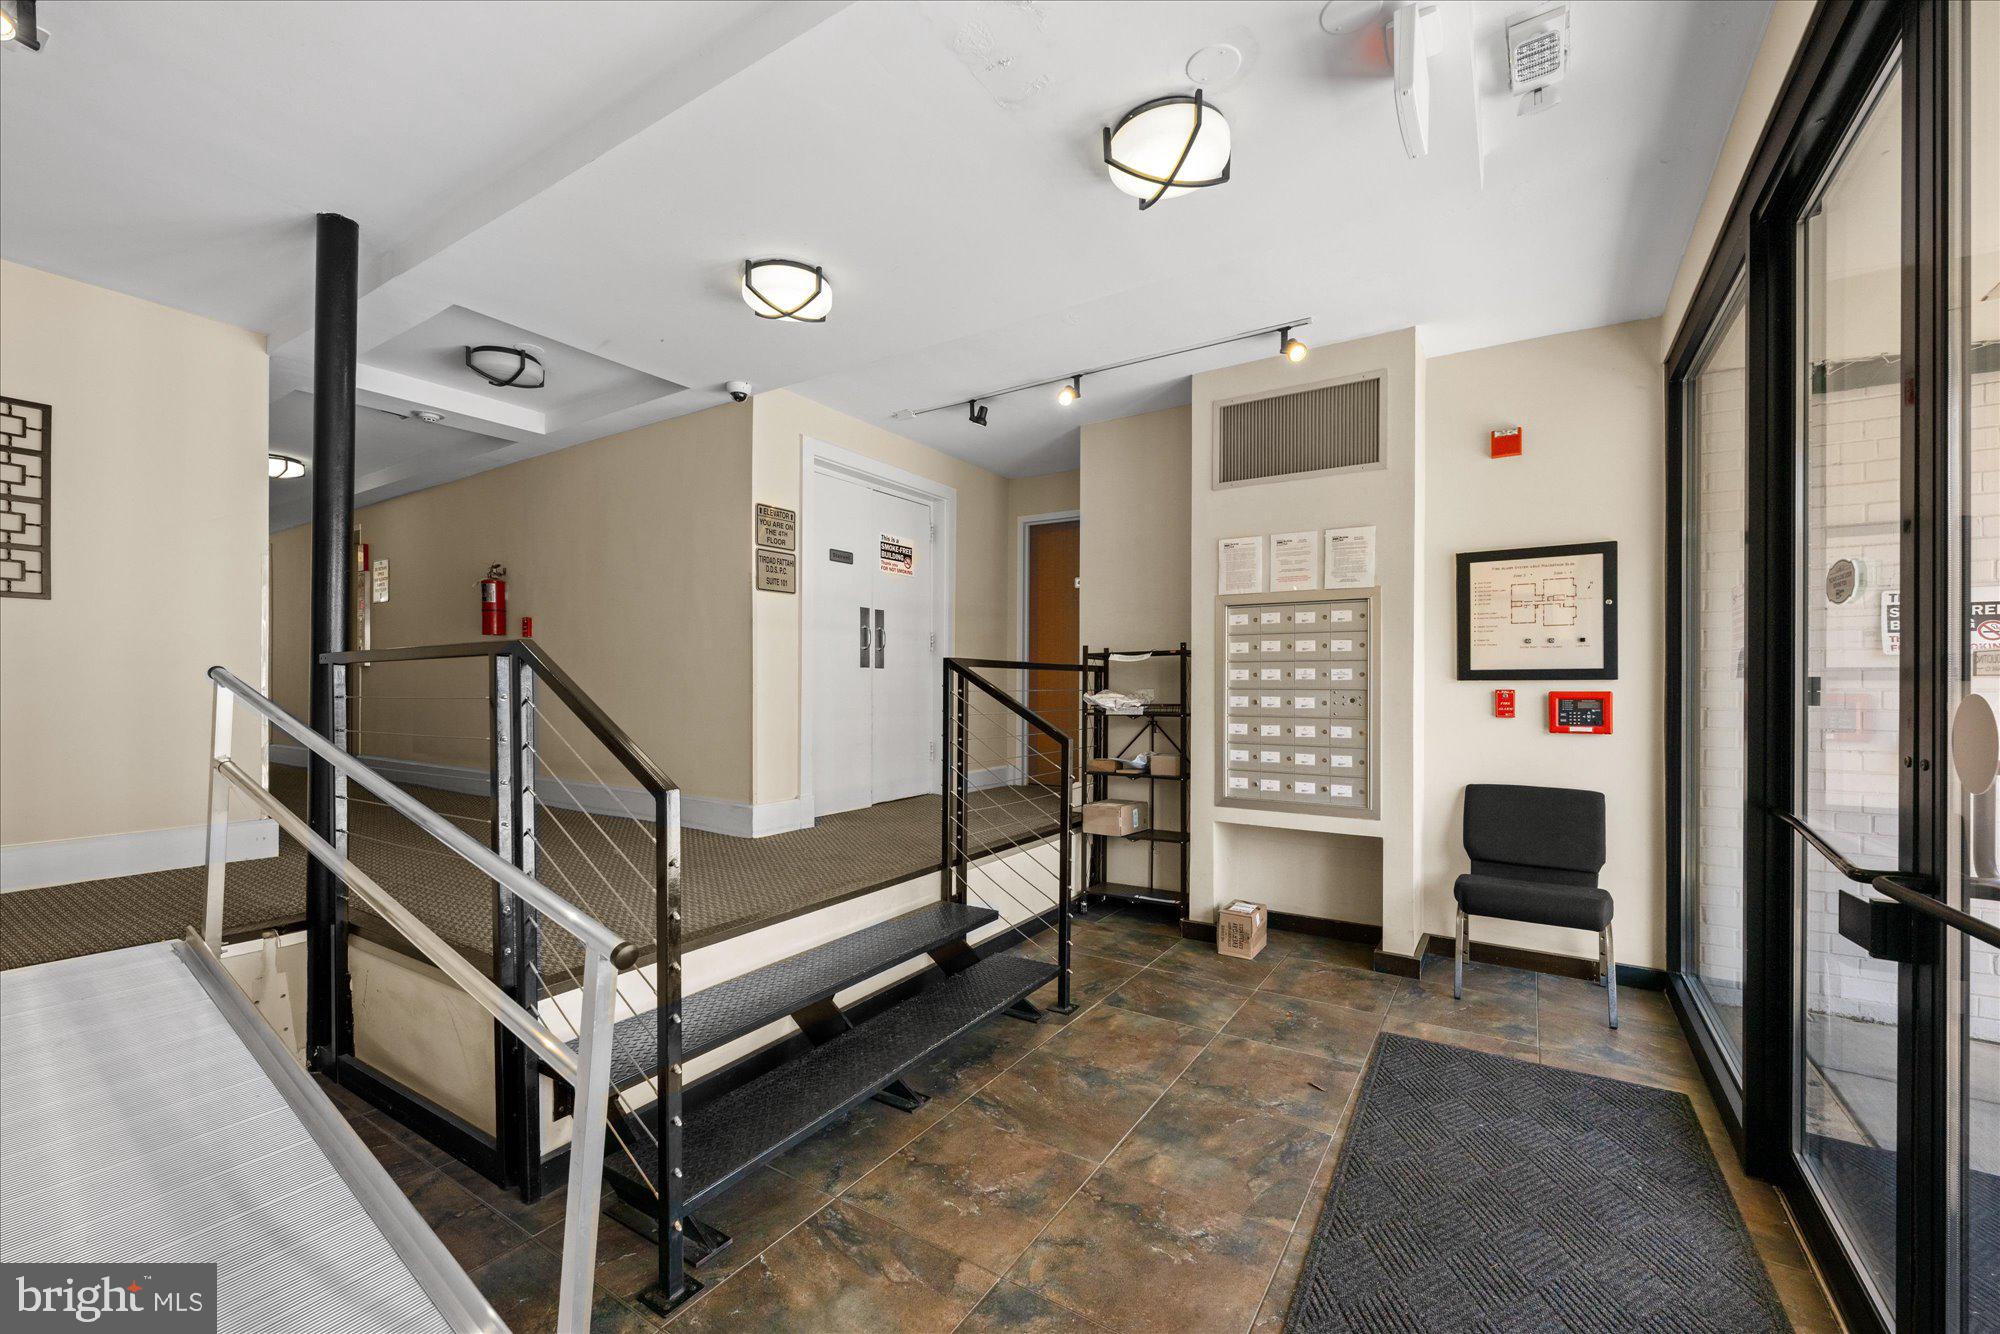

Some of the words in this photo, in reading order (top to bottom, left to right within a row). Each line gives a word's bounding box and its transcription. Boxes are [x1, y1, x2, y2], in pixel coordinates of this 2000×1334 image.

[763, 508, 790, 520] ELEVATOR
[759, 518, 771, 527] YOU
[773, 521, 784, 530] ARE
[785, 523, 793, 532] ON
[765, 527, 777, 537] THE
[766, 537, 786, 546] FLOOR
[881, 534, 891, 542] This
[881, 542, 912, 556] SMOKE-FREE
[881, 551, 904, 562] BUILDING
[765, 577, 779, 586] SUITE
